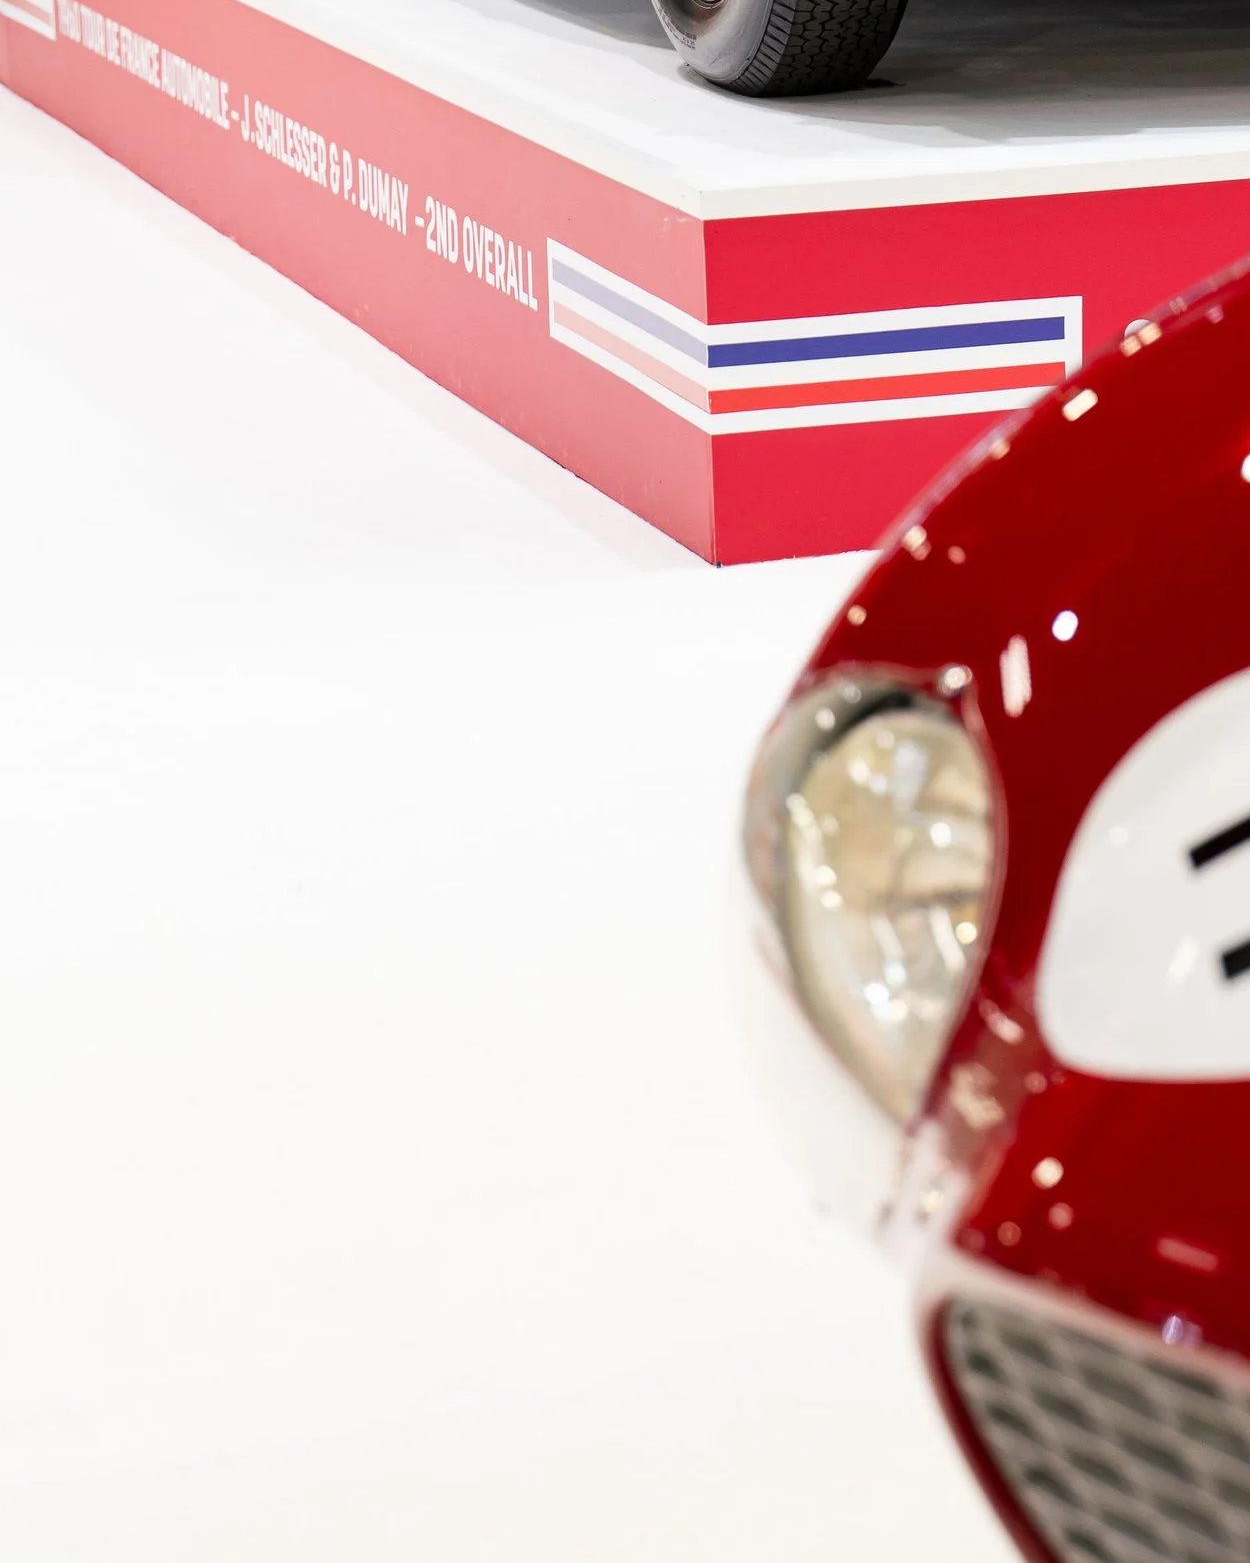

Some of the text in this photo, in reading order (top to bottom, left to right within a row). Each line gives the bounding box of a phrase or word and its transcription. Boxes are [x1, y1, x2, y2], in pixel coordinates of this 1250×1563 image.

[119, 24, 161, 89] FRANCE
[160, 48, 230, 130] AUTOMOBILE
[329, 141, 340, 195] &
[358, 157, 409, 236] DUMAY
[462, 215, 538, 311] OVERALL
